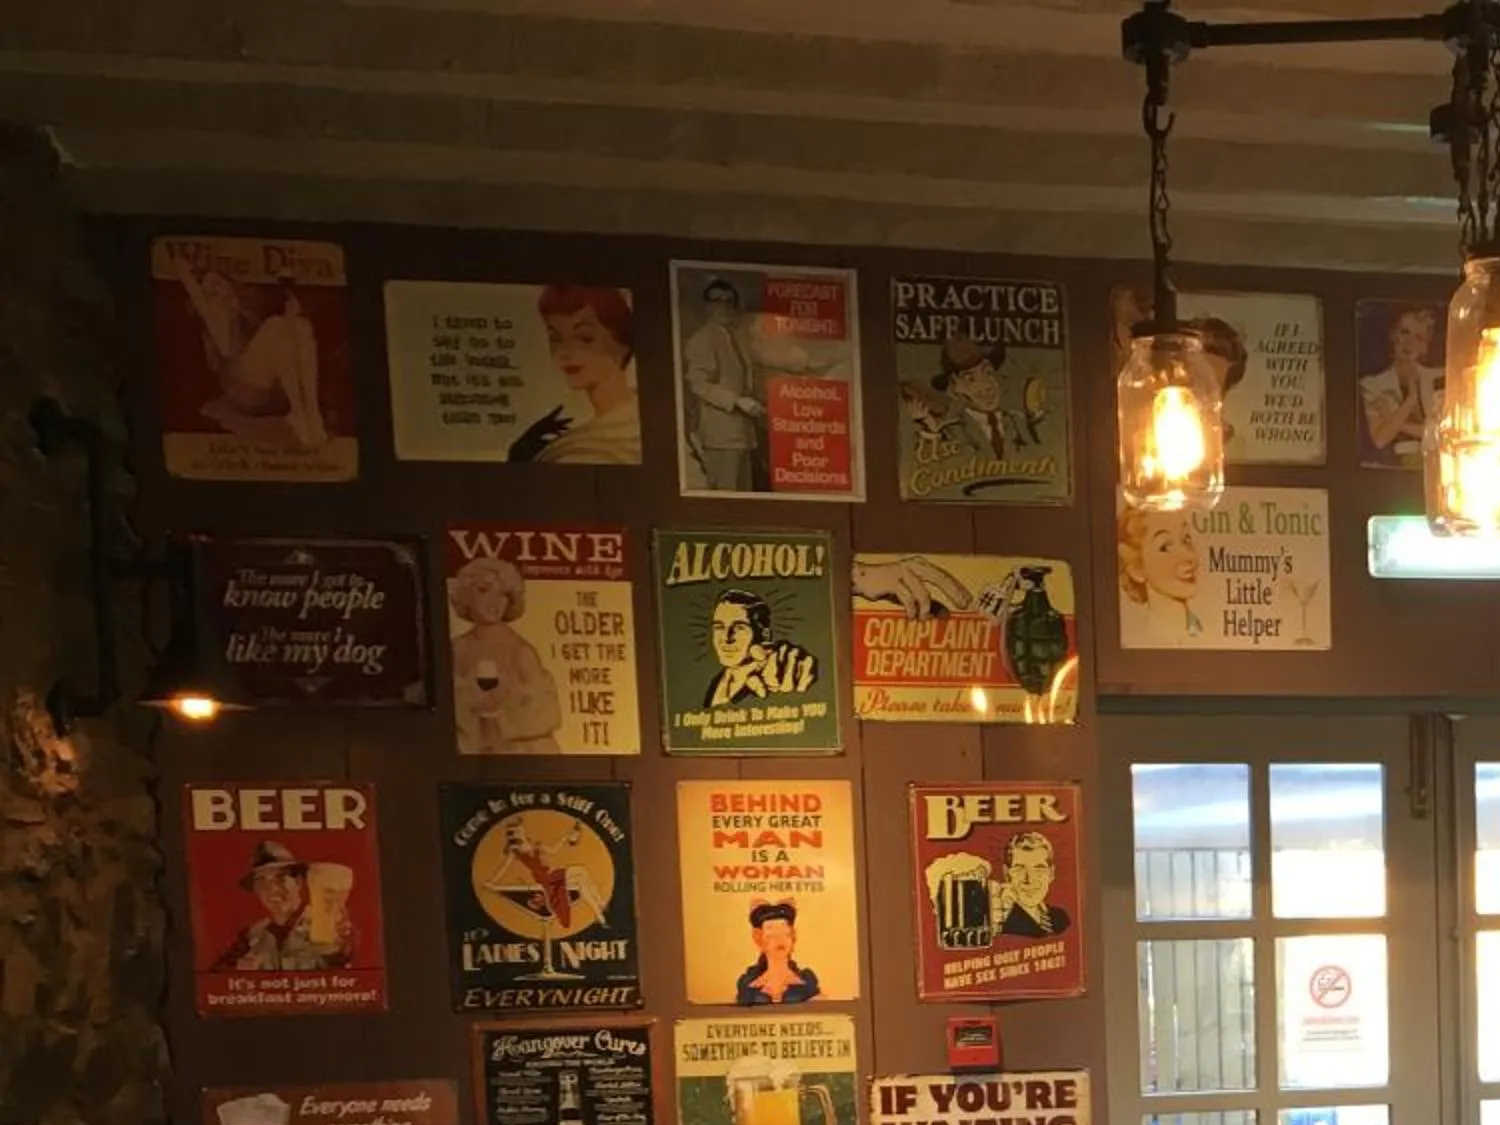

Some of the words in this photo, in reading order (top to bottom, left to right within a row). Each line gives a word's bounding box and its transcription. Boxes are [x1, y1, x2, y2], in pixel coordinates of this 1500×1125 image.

[897, 283, 1059, 313] PRACTICE
[970, 317, 1059, 344] LUNCH
[1265, 358, 1308, 373] WITH
[772, 418, 846, 433] Standards
[1255, 427, 1314, 443] WRONG
[792, 452, 829, 468] Poor
[1238, 501, 1256, 535] &
[1260, 501, 1322, 536] Tonic
[448, 530, 623, 563] WINE
[665, 540, 826, 587] ALCOHOL!
[1208, 545, 1293, 581] Mummy's
[223, 580, 298, 609] know
[297, 581, 386, 620] people
[576, 591, 598, 606] THE
[1226, 577, 1272, 605] Little
[555, 611, 625, 636] OLDER
[863, 618, 993, 650] COMPLAINT
[1223, 609, 1283, 645] Helper
[226, 633, 278, 663] like
[282, 644, 329, 675] my
[332, 634, 388, 675] dog
[562, 644, 590, 660] GET
[597, 644, 626, 662] THE
[570, 667, 611, 685] MORE
[866, 652, 997, 678] DEPARTMENT
[570, 691, 575, 713] I
[580, 691, 615, 715] LIKE
[190, 788, 368, 832] BEER
[709, 793, 823, 813] BEHIND
[712, 815, 764, 829] EVERY
[768, 815, 823, 828] GREAT
[924, 793, 1070, 840] BEER
[712, 830, 823, 849] MAN
[752, 850, 768, 863] IS
[775, 850, 789, 862] A
[712, 865, 825, 880] WOMAN
[713, 881, 766, 893] ROLLING
[769, 881, 792, 892] HER
[796, 881, 825, 892] EYES
[560, 939, 628, 969] NIGHT
[943, 955, 991, 976] HELPING
[943, 971, 973, 991] HAVE
[975, 968, 997, 986] SEX
[463, 986, 635, 1008] EVERYNIGHT
[706, 1023, 776, 1038] EVERYONE
[762, 1041, 777, 1059] TO
[781, 1040, 832, 1059] BELIEVE
[299, 1095, 377, 1118] Everyone
[880, 1086, 917, 1115] IF
[929, 1079, 1077, 1113] YOU'RE
